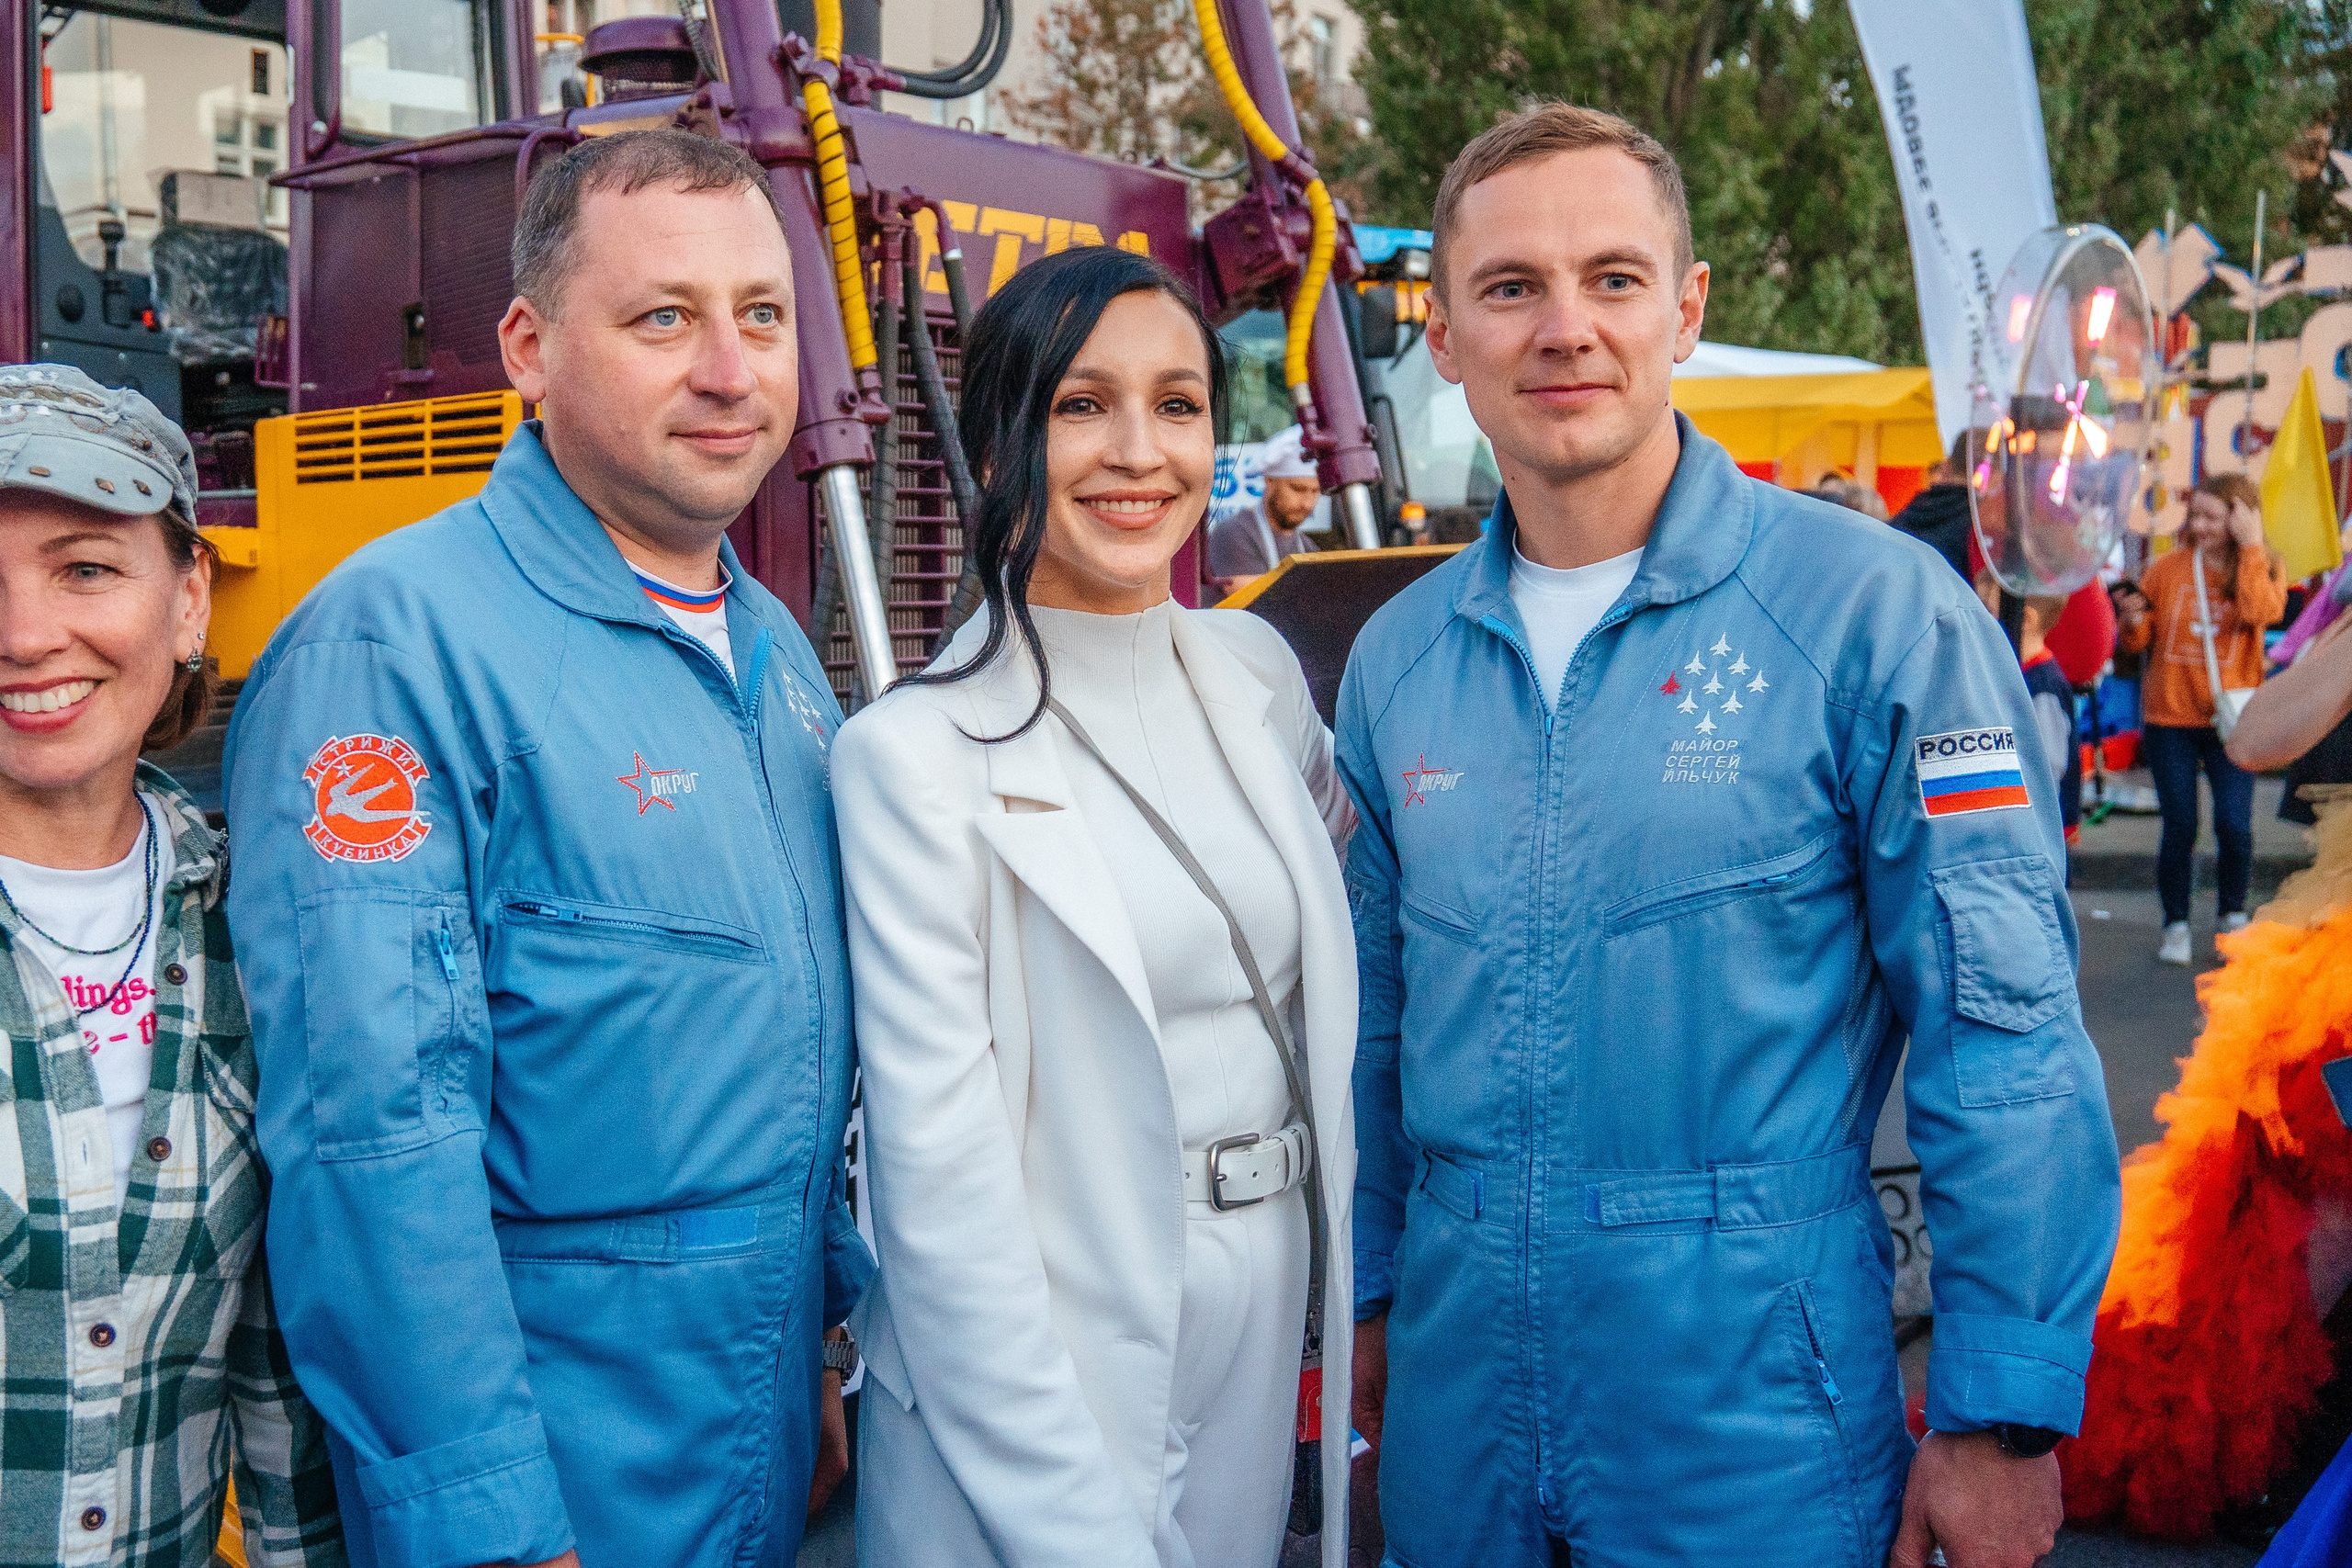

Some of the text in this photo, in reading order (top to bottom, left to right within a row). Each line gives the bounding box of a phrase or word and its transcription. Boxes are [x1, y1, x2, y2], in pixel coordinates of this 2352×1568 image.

[319, 736, 413, 767] СТРИЖИ
[1670, 738, 1738, 752] МАЙОР
[1919, 732, 2015, 761] РОССИЯ
[1666, 753, 1741, 770] СЕРГЕЙ
[650, 773, 699, 796] ОКРУГ
[1418, 773, 1465, 792] ОКРУГ
[320, 834, 413, 860] КУБИНКА
